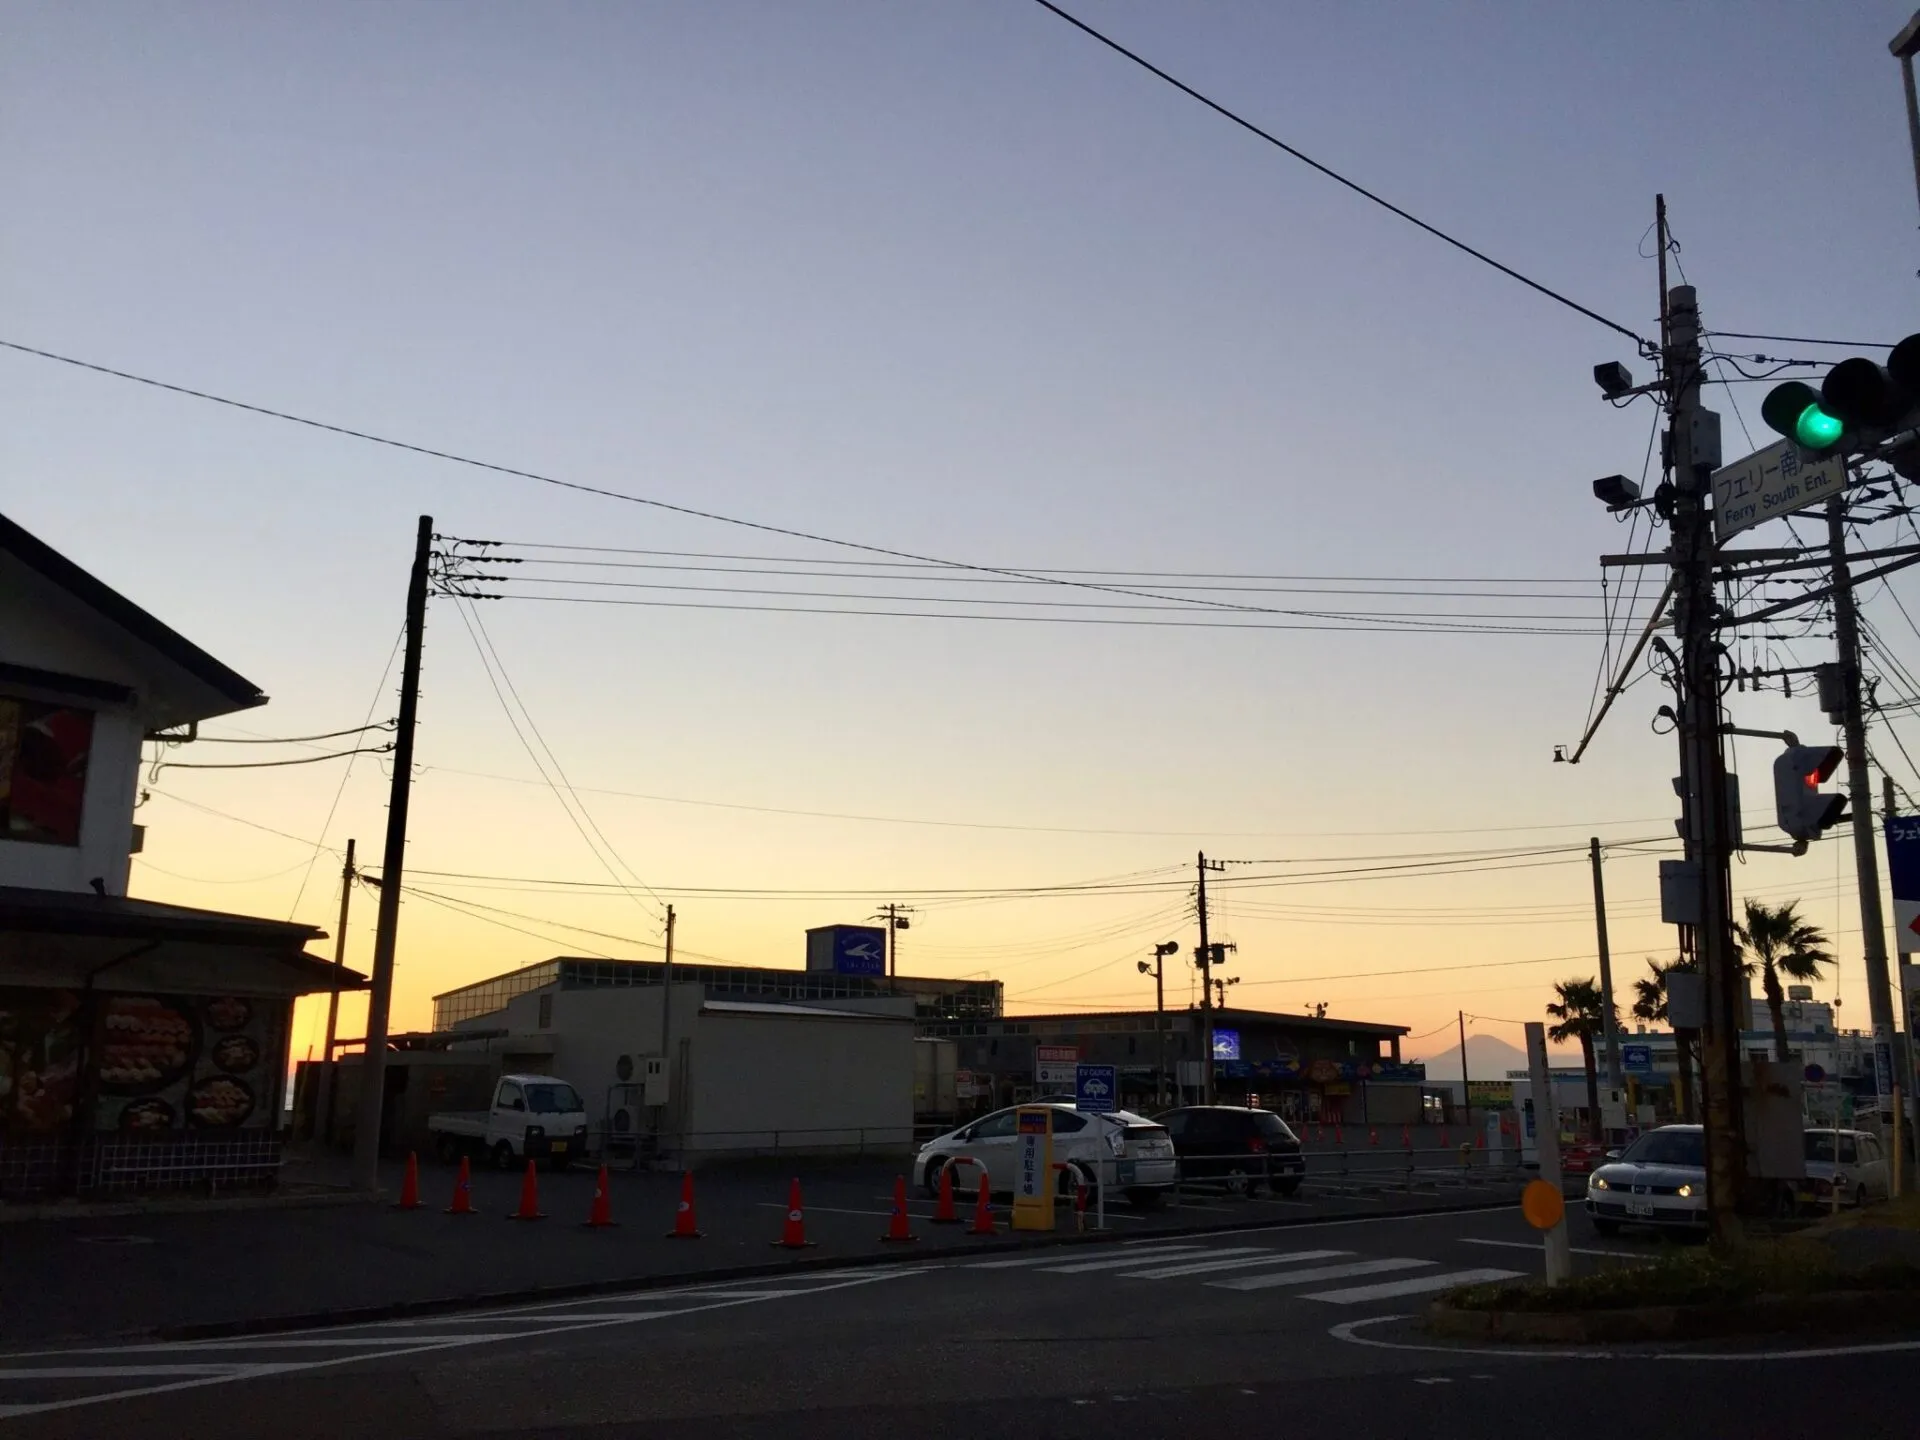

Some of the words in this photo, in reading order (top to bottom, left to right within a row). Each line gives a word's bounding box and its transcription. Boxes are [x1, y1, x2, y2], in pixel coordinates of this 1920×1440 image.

[1717, 449, 1834, 508] フェリー南
[1725, 503, 1757, 525] Ferry
[1762, 483, 1800, 510] South
[1804, 470, 1832, 493] Ent.
